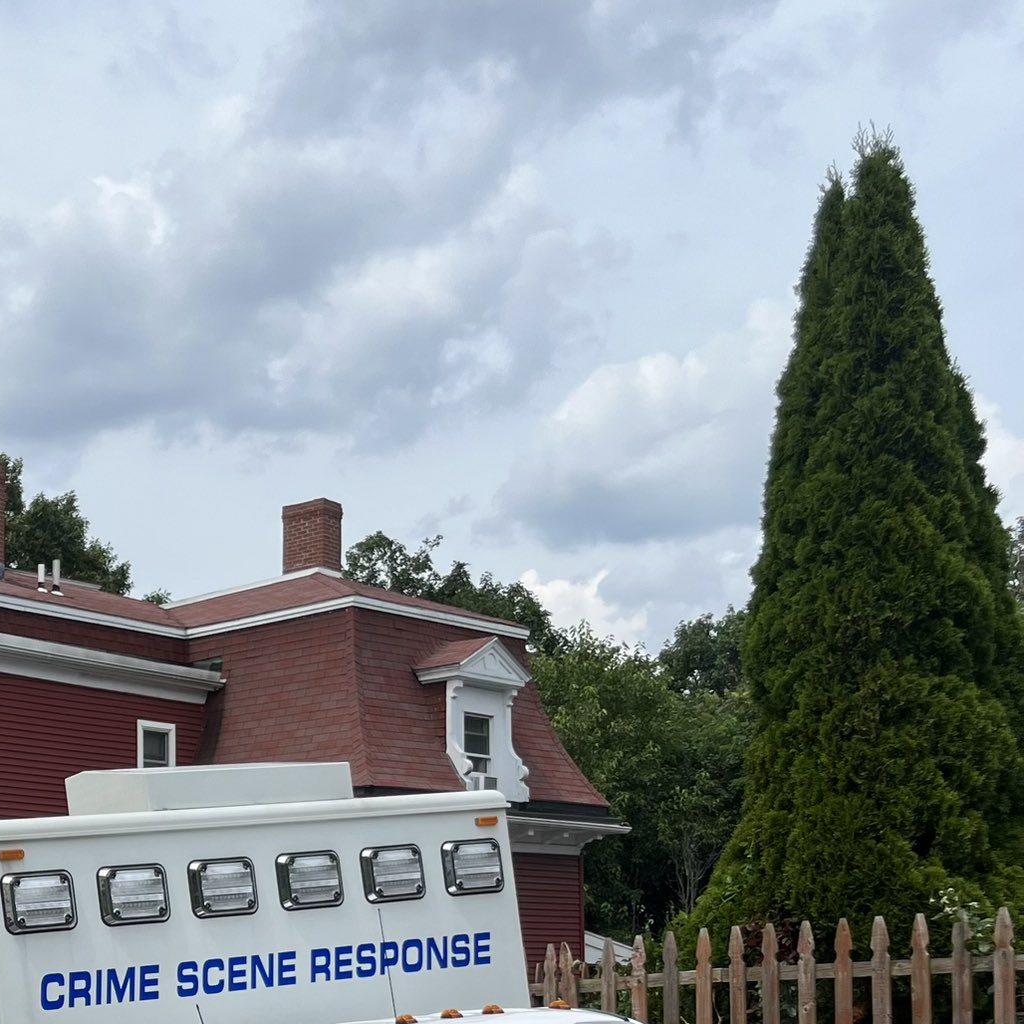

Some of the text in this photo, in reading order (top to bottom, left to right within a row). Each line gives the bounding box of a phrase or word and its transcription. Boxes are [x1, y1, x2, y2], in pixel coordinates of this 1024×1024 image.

[40, 931, 492, 1012] CRIME SCENE RESPONSE
